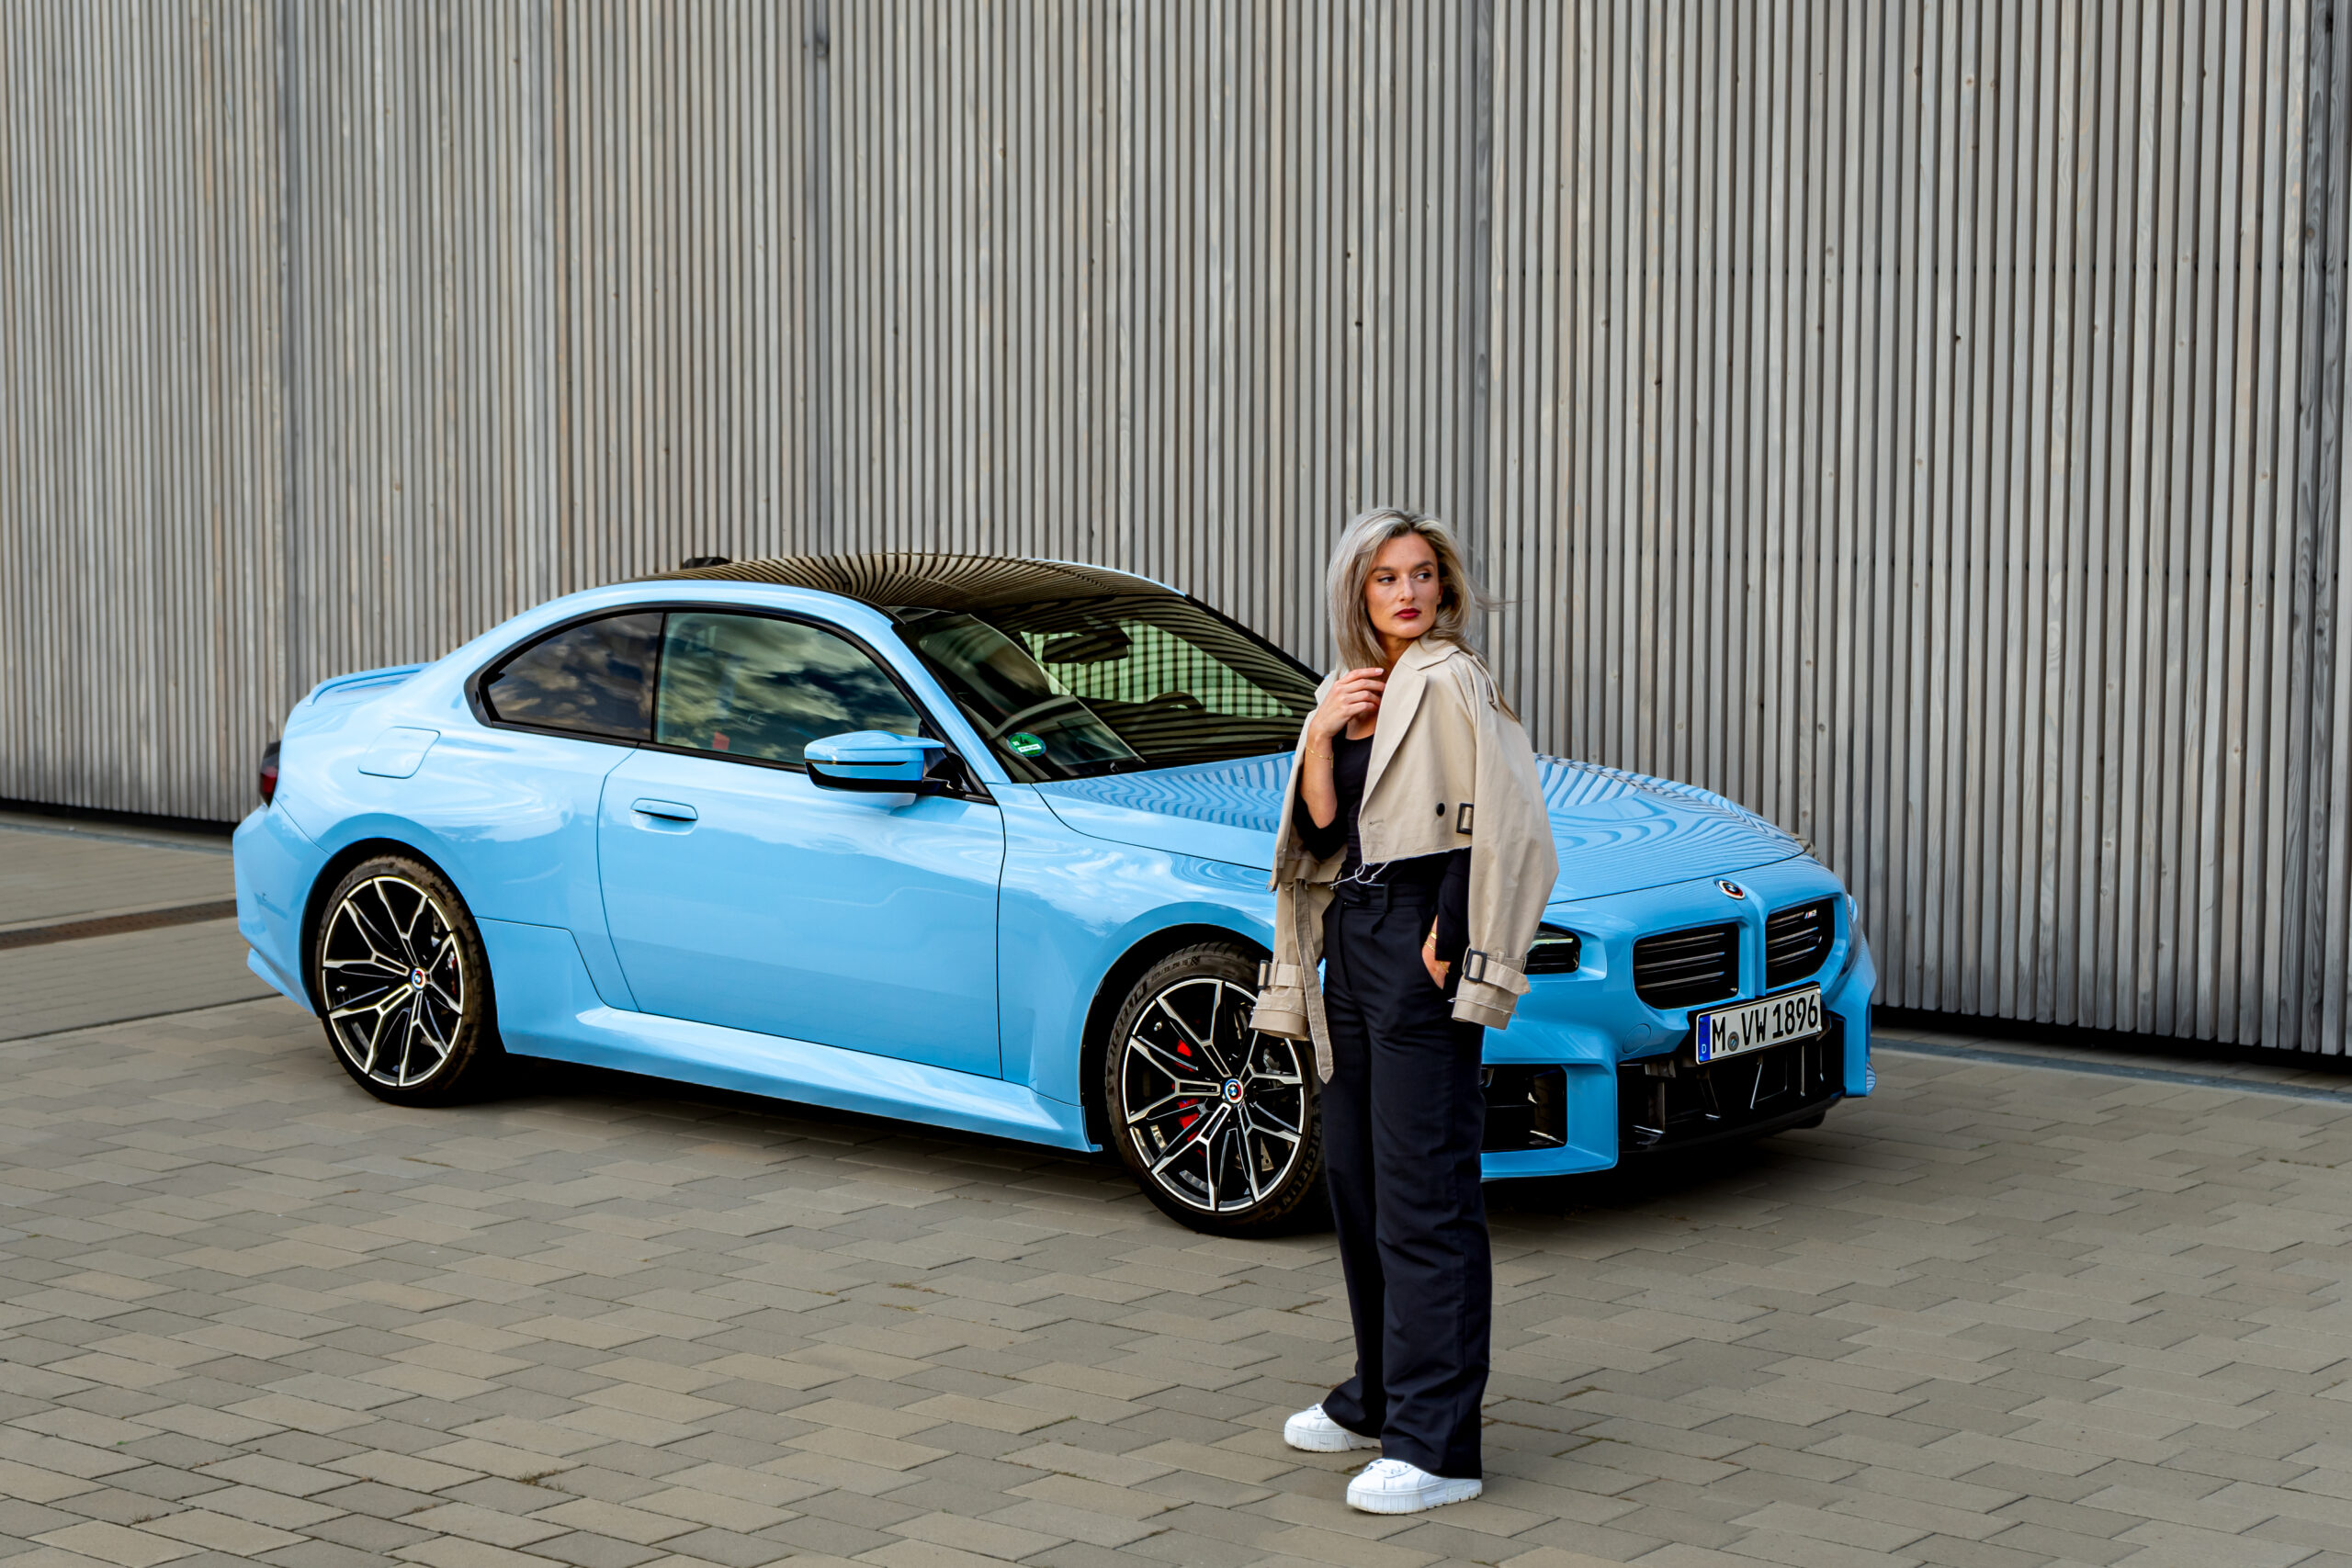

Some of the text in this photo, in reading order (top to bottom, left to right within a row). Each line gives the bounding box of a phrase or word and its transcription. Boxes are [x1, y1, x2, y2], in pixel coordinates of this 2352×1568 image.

[1701, 1043, 1707, 1054] D
[1712, 994, 1818, 1054] M VW 1896
[1281, 1122, 1321, 1206] MICHELIN
